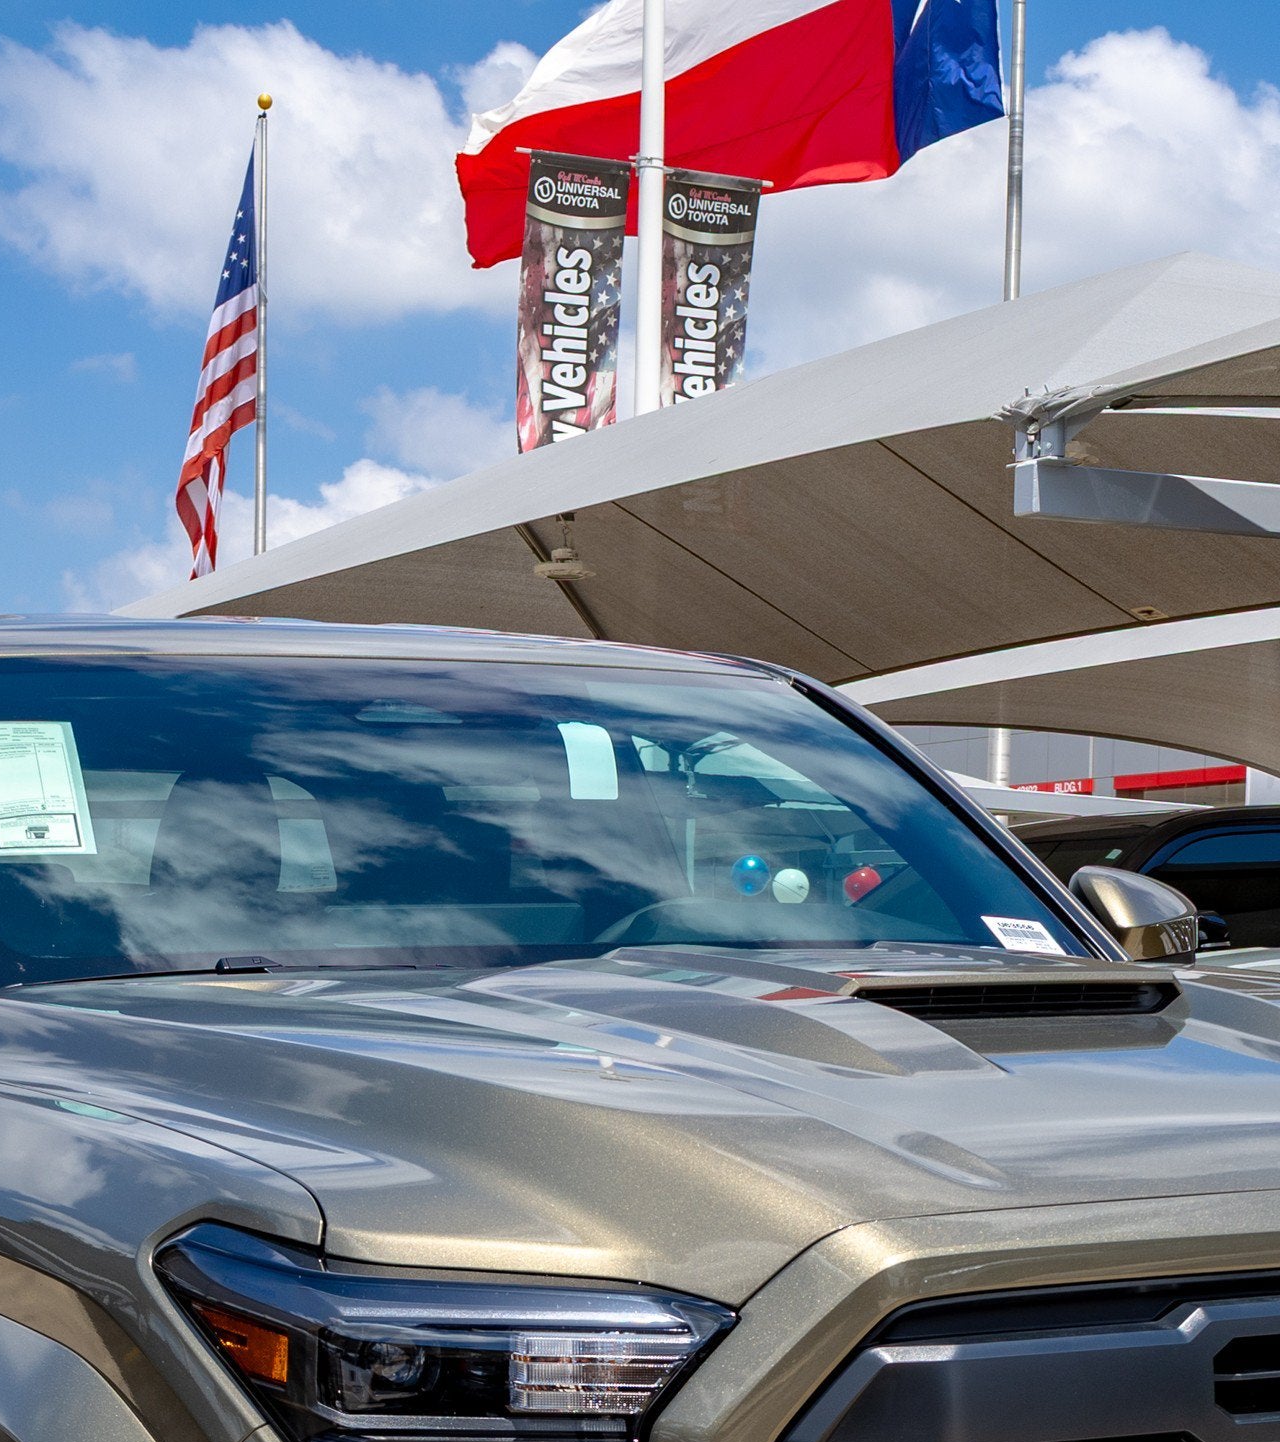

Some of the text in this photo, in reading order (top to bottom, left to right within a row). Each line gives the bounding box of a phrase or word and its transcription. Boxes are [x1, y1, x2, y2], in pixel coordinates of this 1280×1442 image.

[557, 181, 621, 199] UNIVERSAL
[556, 193, 600, 209] TOYOTA
[688, 198, 752, 216] UNIVERSAL
[687, 209, 729, 226] TOYOTA
[542, 246, 593, 412] Vehicles
